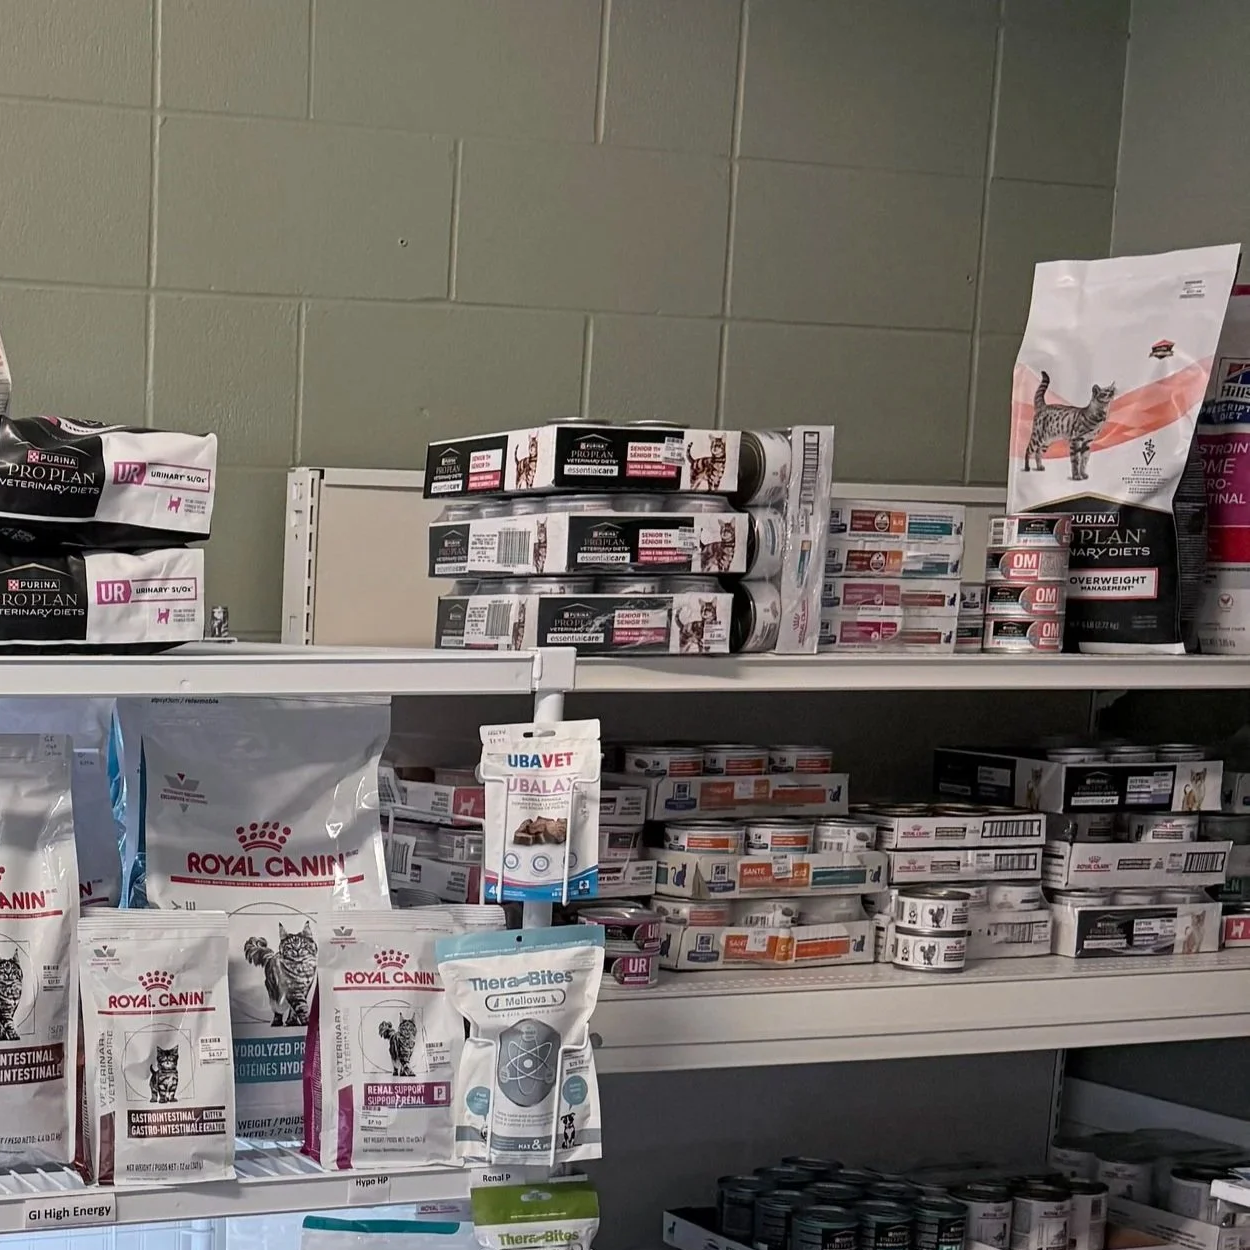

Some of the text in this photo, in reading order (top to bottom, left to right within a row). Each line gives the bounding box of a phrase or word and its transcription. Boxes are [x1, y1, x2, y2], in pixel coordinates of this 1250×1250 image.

[1219, 410, 1242, 420] DIET
[38, 453, 76, 466] PURINA
[571, 450, 614, 458] PRO PLAN
[567, 466, 614, 475] essentialcare
[0, 477, 100, 495] VETERINARY DIETS
[1080, 529, 1141, 544] PLAN
[1108, 546, 1150, 556] DIETS
[580, 554, 626, 563] essentialcare
[1013, 553, 1037, 570] OM
[20, 580, 57, 590] PURINA
[1069, 576, 1147, 586] OVERWEIGHT
[100, 583, 125, 601] UR
[1036, 588, 1056, 603] OM
[53, 608, 85, 616] DIETS
[550, 634, 600, 643] essentialcare
[507, 752, 573, 768] UBAVET
[507, 777, 579, 793] UBALAX
[187, 852, 345, 877] ROYAL CANIN
[647, 923, 660, 939] UR
[629, 958, 647, 973] UR
[344, 972, 435, 985] ROYAL CANIN
[108, 990, 206, 1009] ROYAL CANIN
[505, 994, 547, 1005] Mellows
[367, 1085, 426, 1096] RENAL SUPPORT
[436, 1086, 444, 1099] P
[367, 1095, 426, 1106] SUPPORT RENAL
[355, 1176, 388, 1188] Hypo HP
[28, 1203, 112, 1224] GI High Energy
